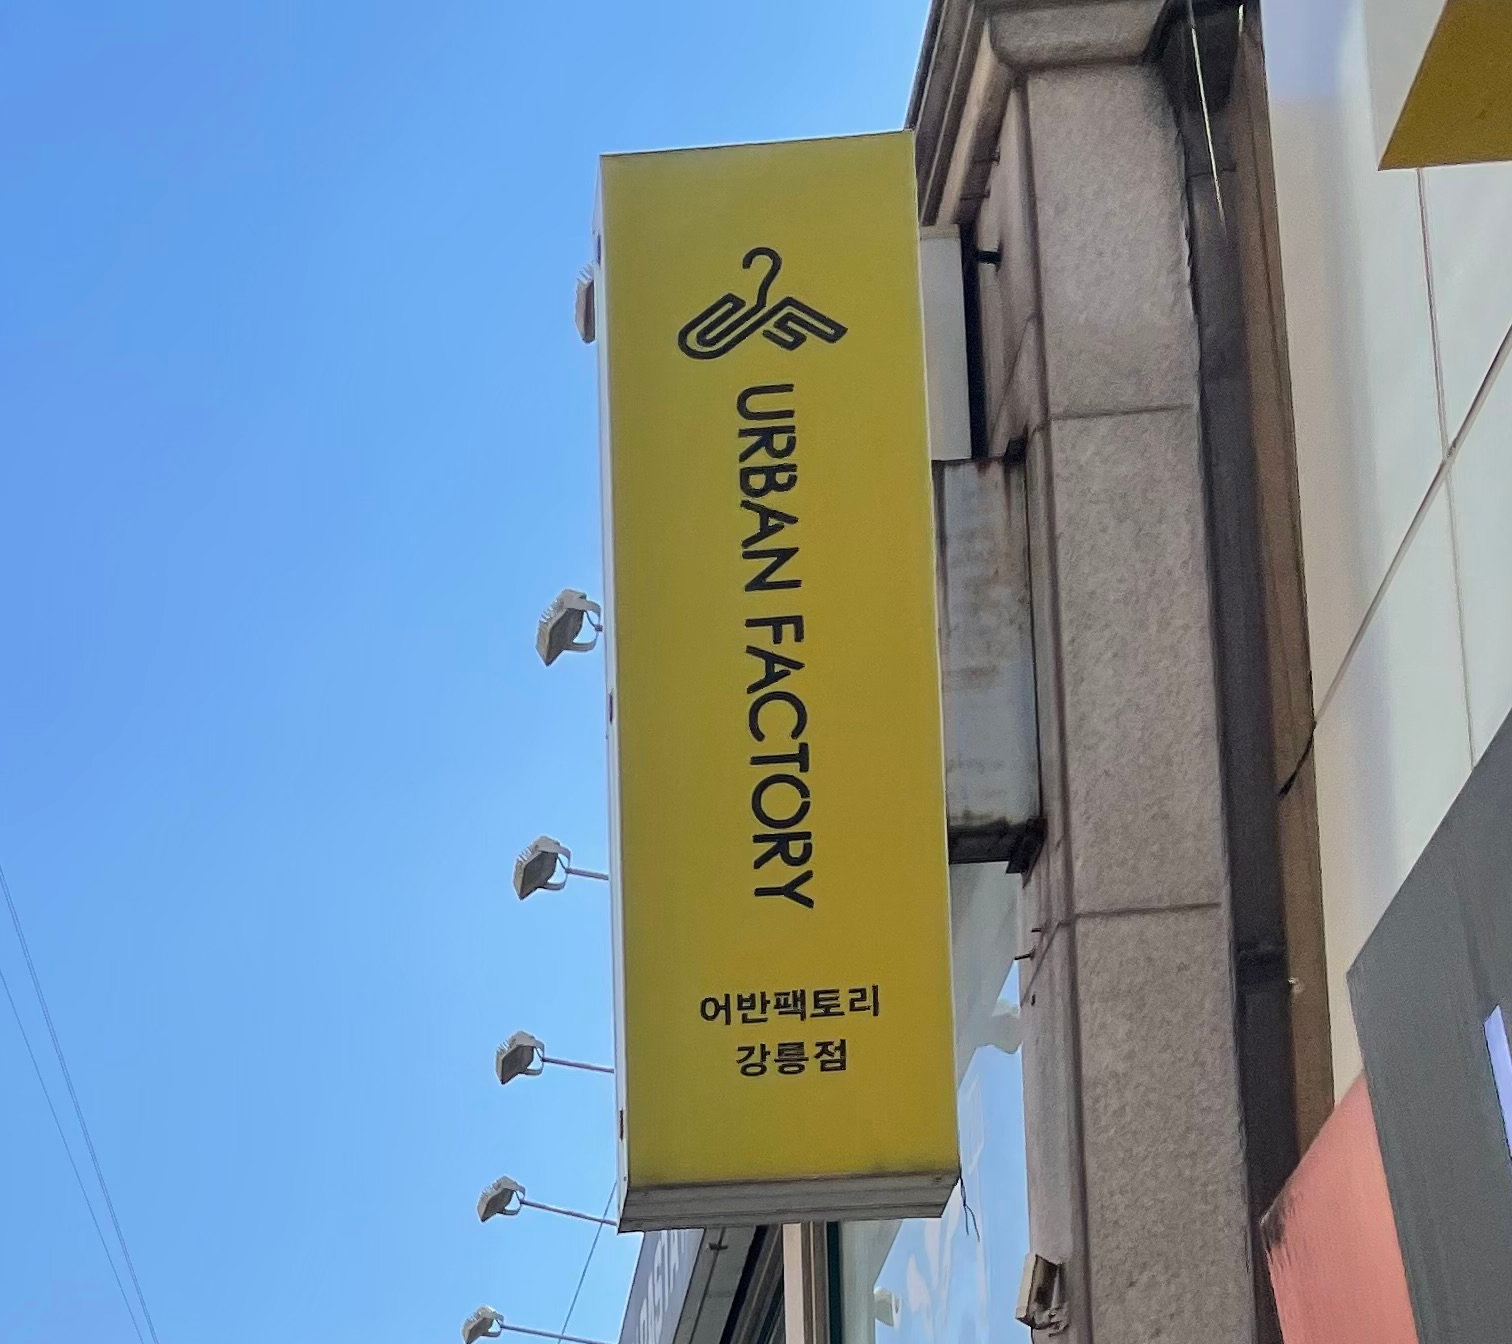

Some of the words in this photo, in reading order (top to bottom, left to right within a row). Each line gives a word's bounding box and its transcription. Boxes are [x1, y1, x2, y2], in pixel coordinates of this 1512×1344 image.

[736, 383, 803, 593] URBAN
[744, 614, 815, 909] FACTORY
[699, 984, 881, 1026] 어반팩토리
[736, 1039, 848, 1077] 강릉점
